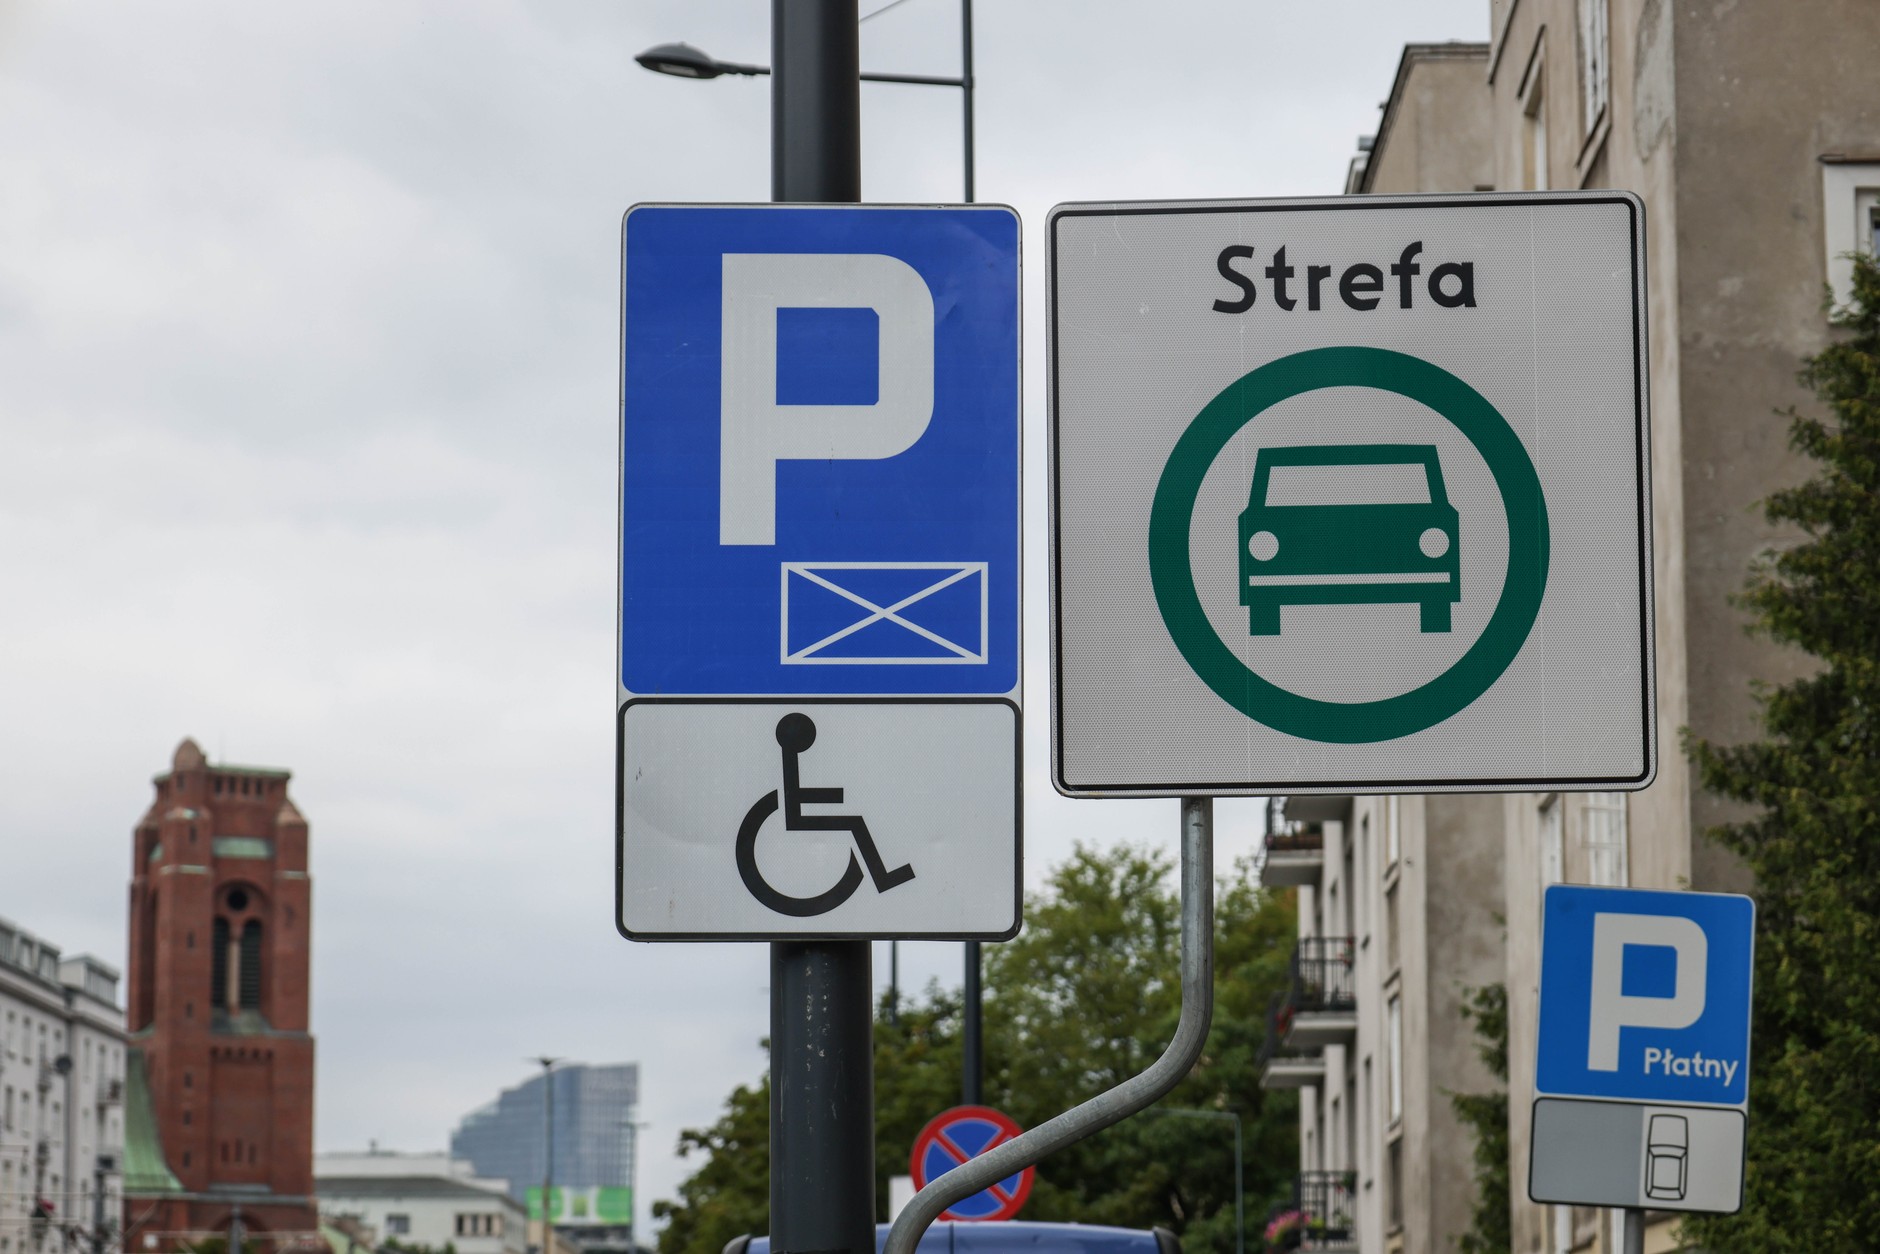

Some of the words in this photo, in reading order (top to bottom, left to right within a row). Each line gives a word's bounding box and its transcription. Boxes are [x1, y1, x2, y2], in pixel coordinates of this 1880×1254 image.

[1212, 241, 1477, 314] Strefa
[720, 253, 934, 545] P
[1587, 912, 1708, 1072] P
[1644, 1047, 1739, 1087] Płatny
